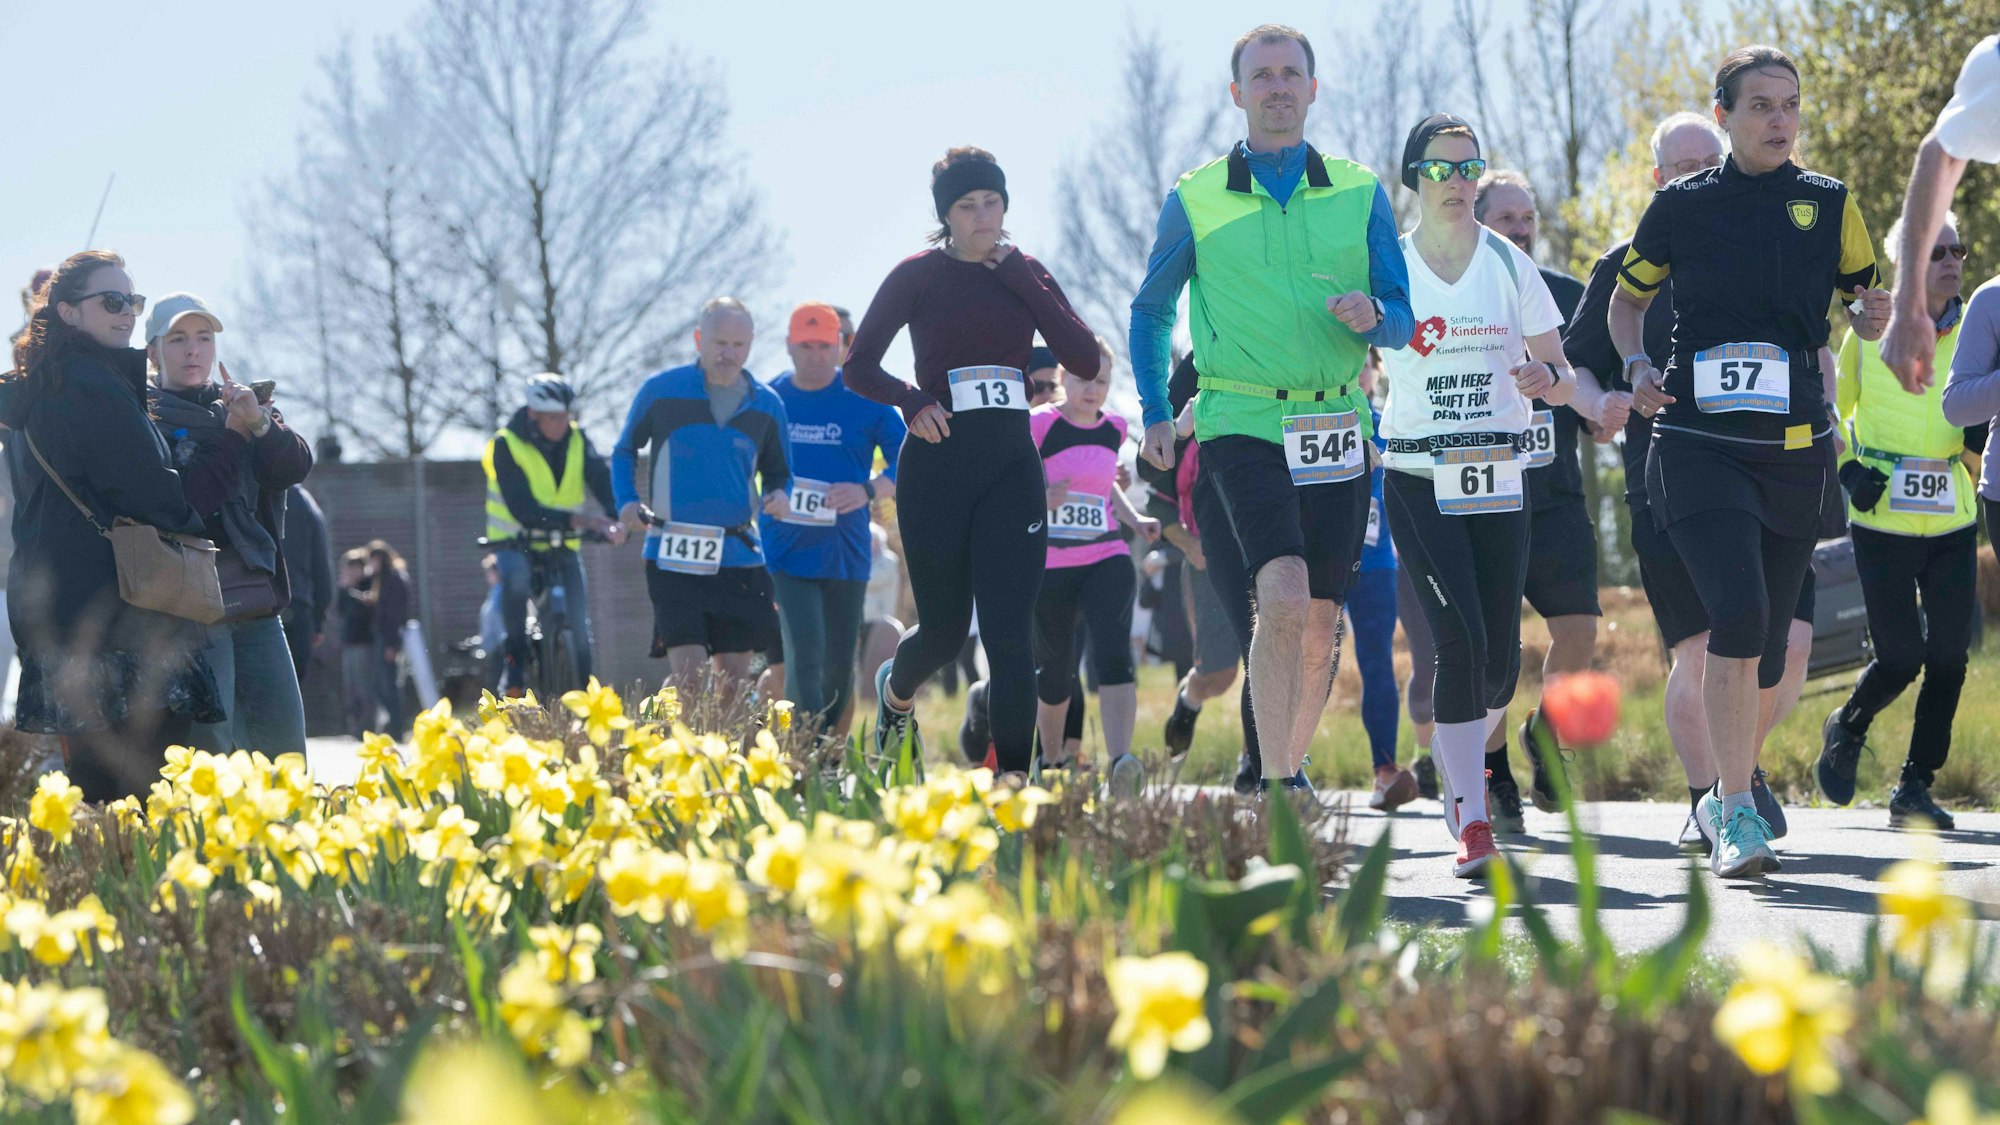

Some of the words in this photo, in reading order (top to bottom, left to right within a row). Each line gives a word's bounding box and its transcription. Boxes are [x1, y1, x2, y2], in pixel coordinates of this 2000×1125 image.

[1675, 176, 1719, 191] FUSION
[1796, 174, 1839, 190] FUSION
[1795, 207, 1811, 218] TuS
[1450, 316, 1484, 325] Stiftung
[1451, 324, 1509, 337] KinderHerz
[1426, 374, 1458, 391] MEIN
[1461, 372, 1493, 388] HERZ
[1720, 361, 1763, 392] 57
[975, 381, 1010, 406] 13
[1429, 390, 1464, 409] LÄUFT
[1467, 388, 1490, 408] FÜR
[1300, 430, 1357, 465] 546
[1428, 433, 1496, 449] SUNDRIED
[1461, 464, 1495, 496] 61
[1903, 473, 1948, 498] 598
[1052, 505, 1103, 527] 1388
[665, 536, 717, 561] 1412
